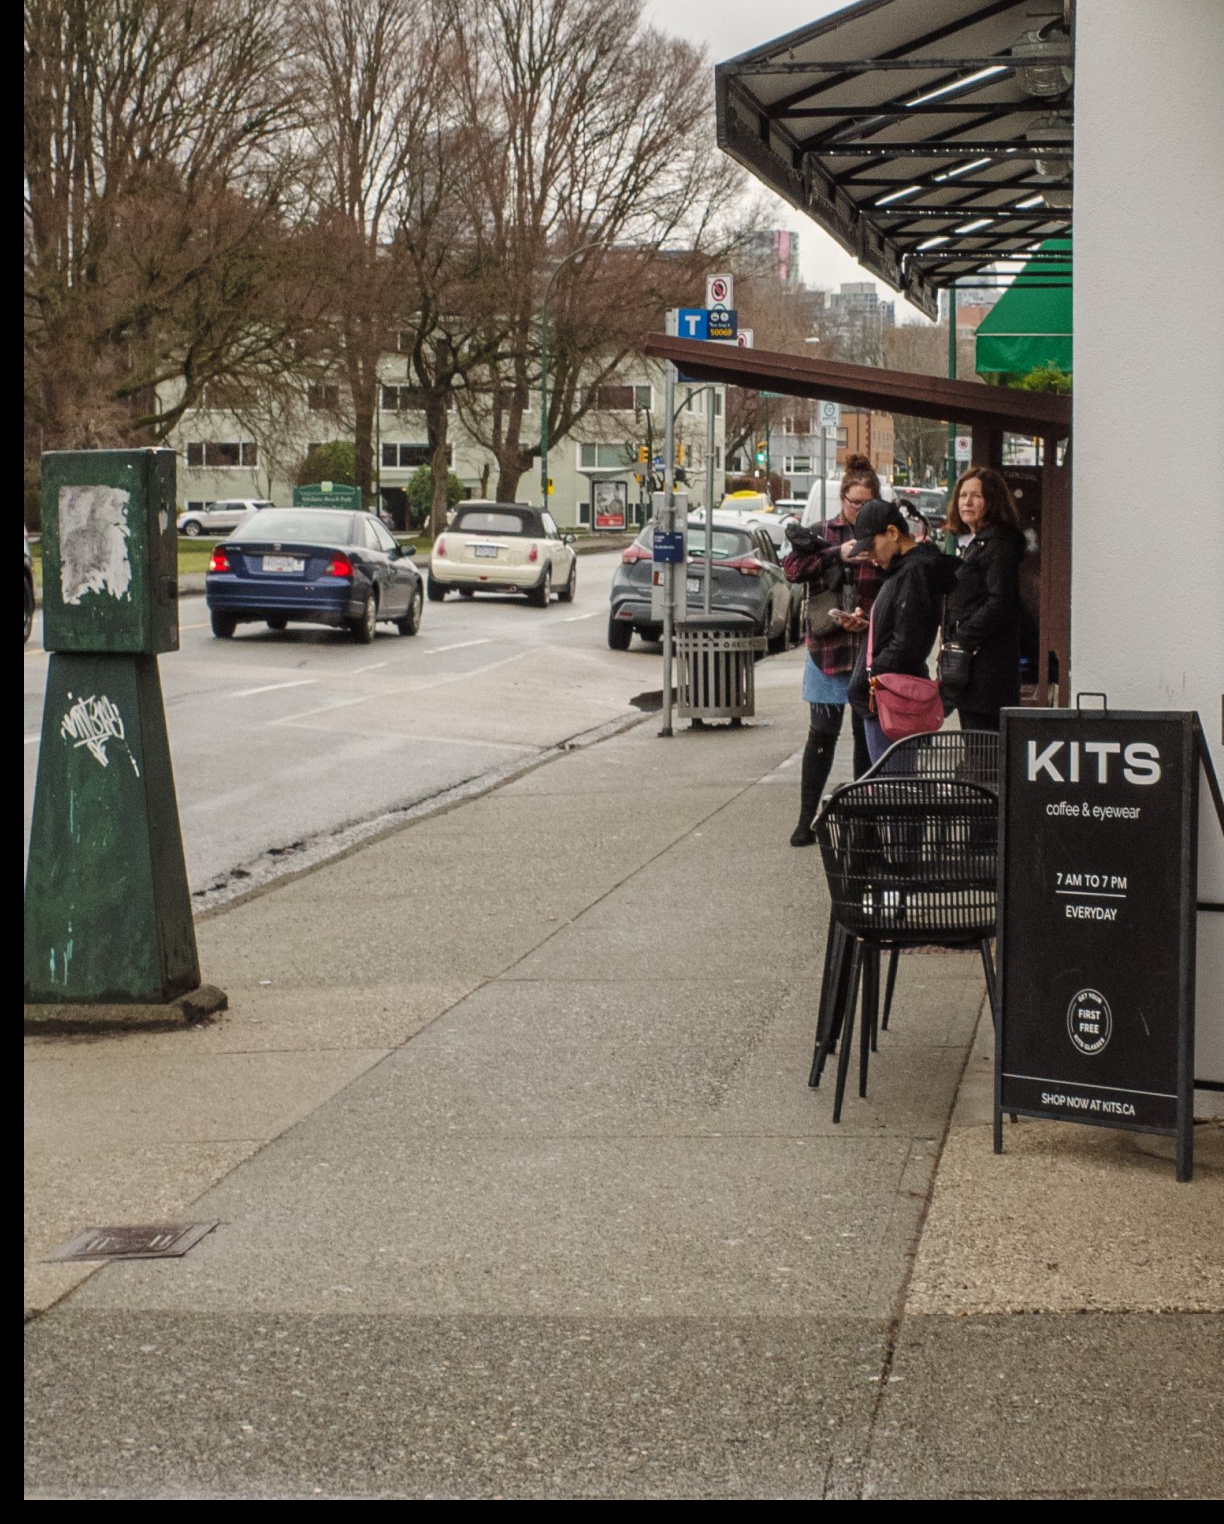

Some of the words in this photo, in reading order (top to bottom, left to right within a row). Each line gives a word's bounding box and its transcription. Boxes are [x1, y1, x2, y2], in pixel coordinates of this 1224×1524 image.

[685, 315, 701, 336] T
[1027, 740, 1161, 785] KITS
[1046, 801, 1080, 816] coffee
[1082, 802, 1090, 817] &
[1092, 805, 1141, 821] eyewear
[1056, 872, 1063, 885] 7
[1065, 873, 1082, 886] AM
[1084, 874, 1100, 888] TO
[1102, 875, 1108, 888] 7
[1111, 876, 1128, 889] PM
[1065, 905, 1118, 921] EVERYDAY
[1078, 1008, 1101, 1020] FIRST
[1079, 1022, 1100, 1034] FREE
[1041, 1092, 1066, 1106] SHOP
[1067, 1096, 1090, 1110] NOW
[1089, 1099, 1102, 1111] AT
